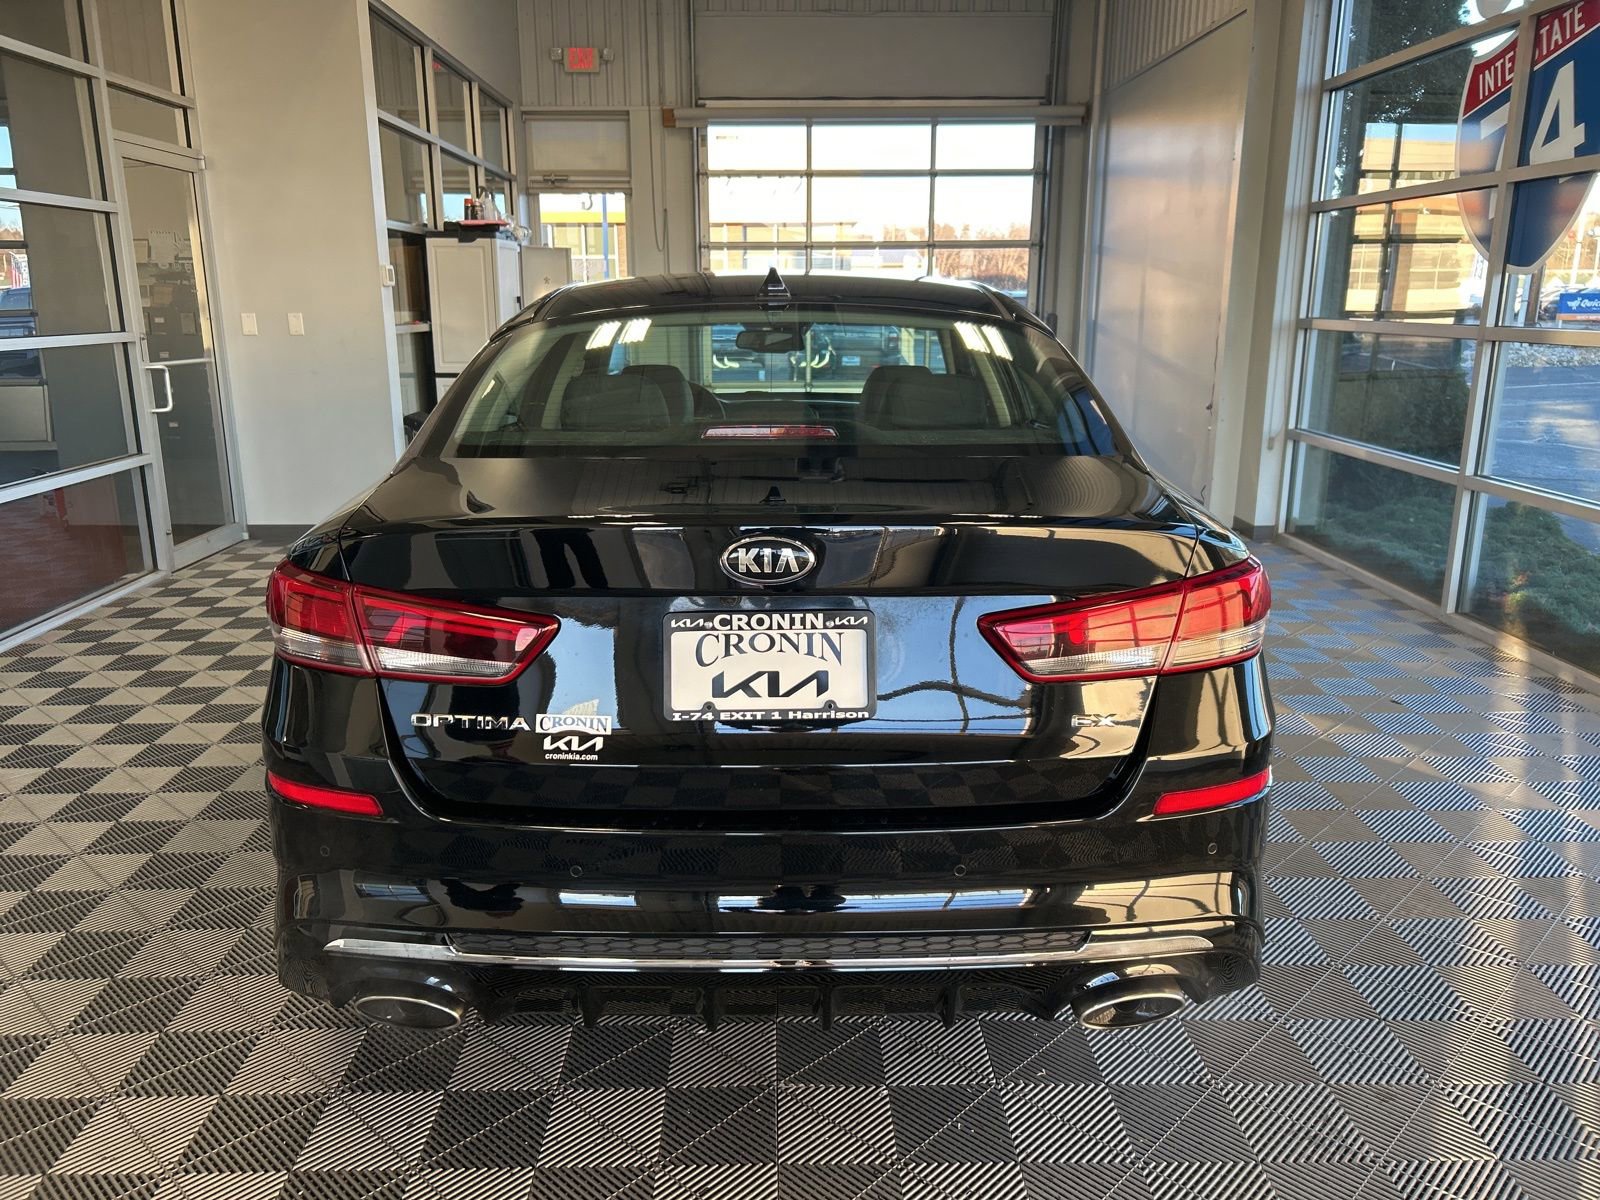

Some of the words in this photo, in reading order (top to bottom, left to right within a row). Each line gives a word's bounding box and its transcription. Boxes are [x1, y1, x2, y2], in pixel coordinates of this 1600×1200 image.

[1479, 1, 1585, 100] INTETATE
[737, 547, 800, 573] KIA
[713, 613, 824, 631] CRONIN
[695, 632, 844, 668] CRONIN
[711, 670, 829, 698] KIA
[410, 713, 531, 731] OPTIMA
[540, 715, 608, 733] CRONIN
[672, 712, 715, 721] I-74
[719, 711, 765, 720] EXIT
[771, 711, 782, 720] 1
[787, 710, 869, 720] Harrison
[1071, 713, 1117, 727] EX
[544, 752, 599, 761] croninkia.com
